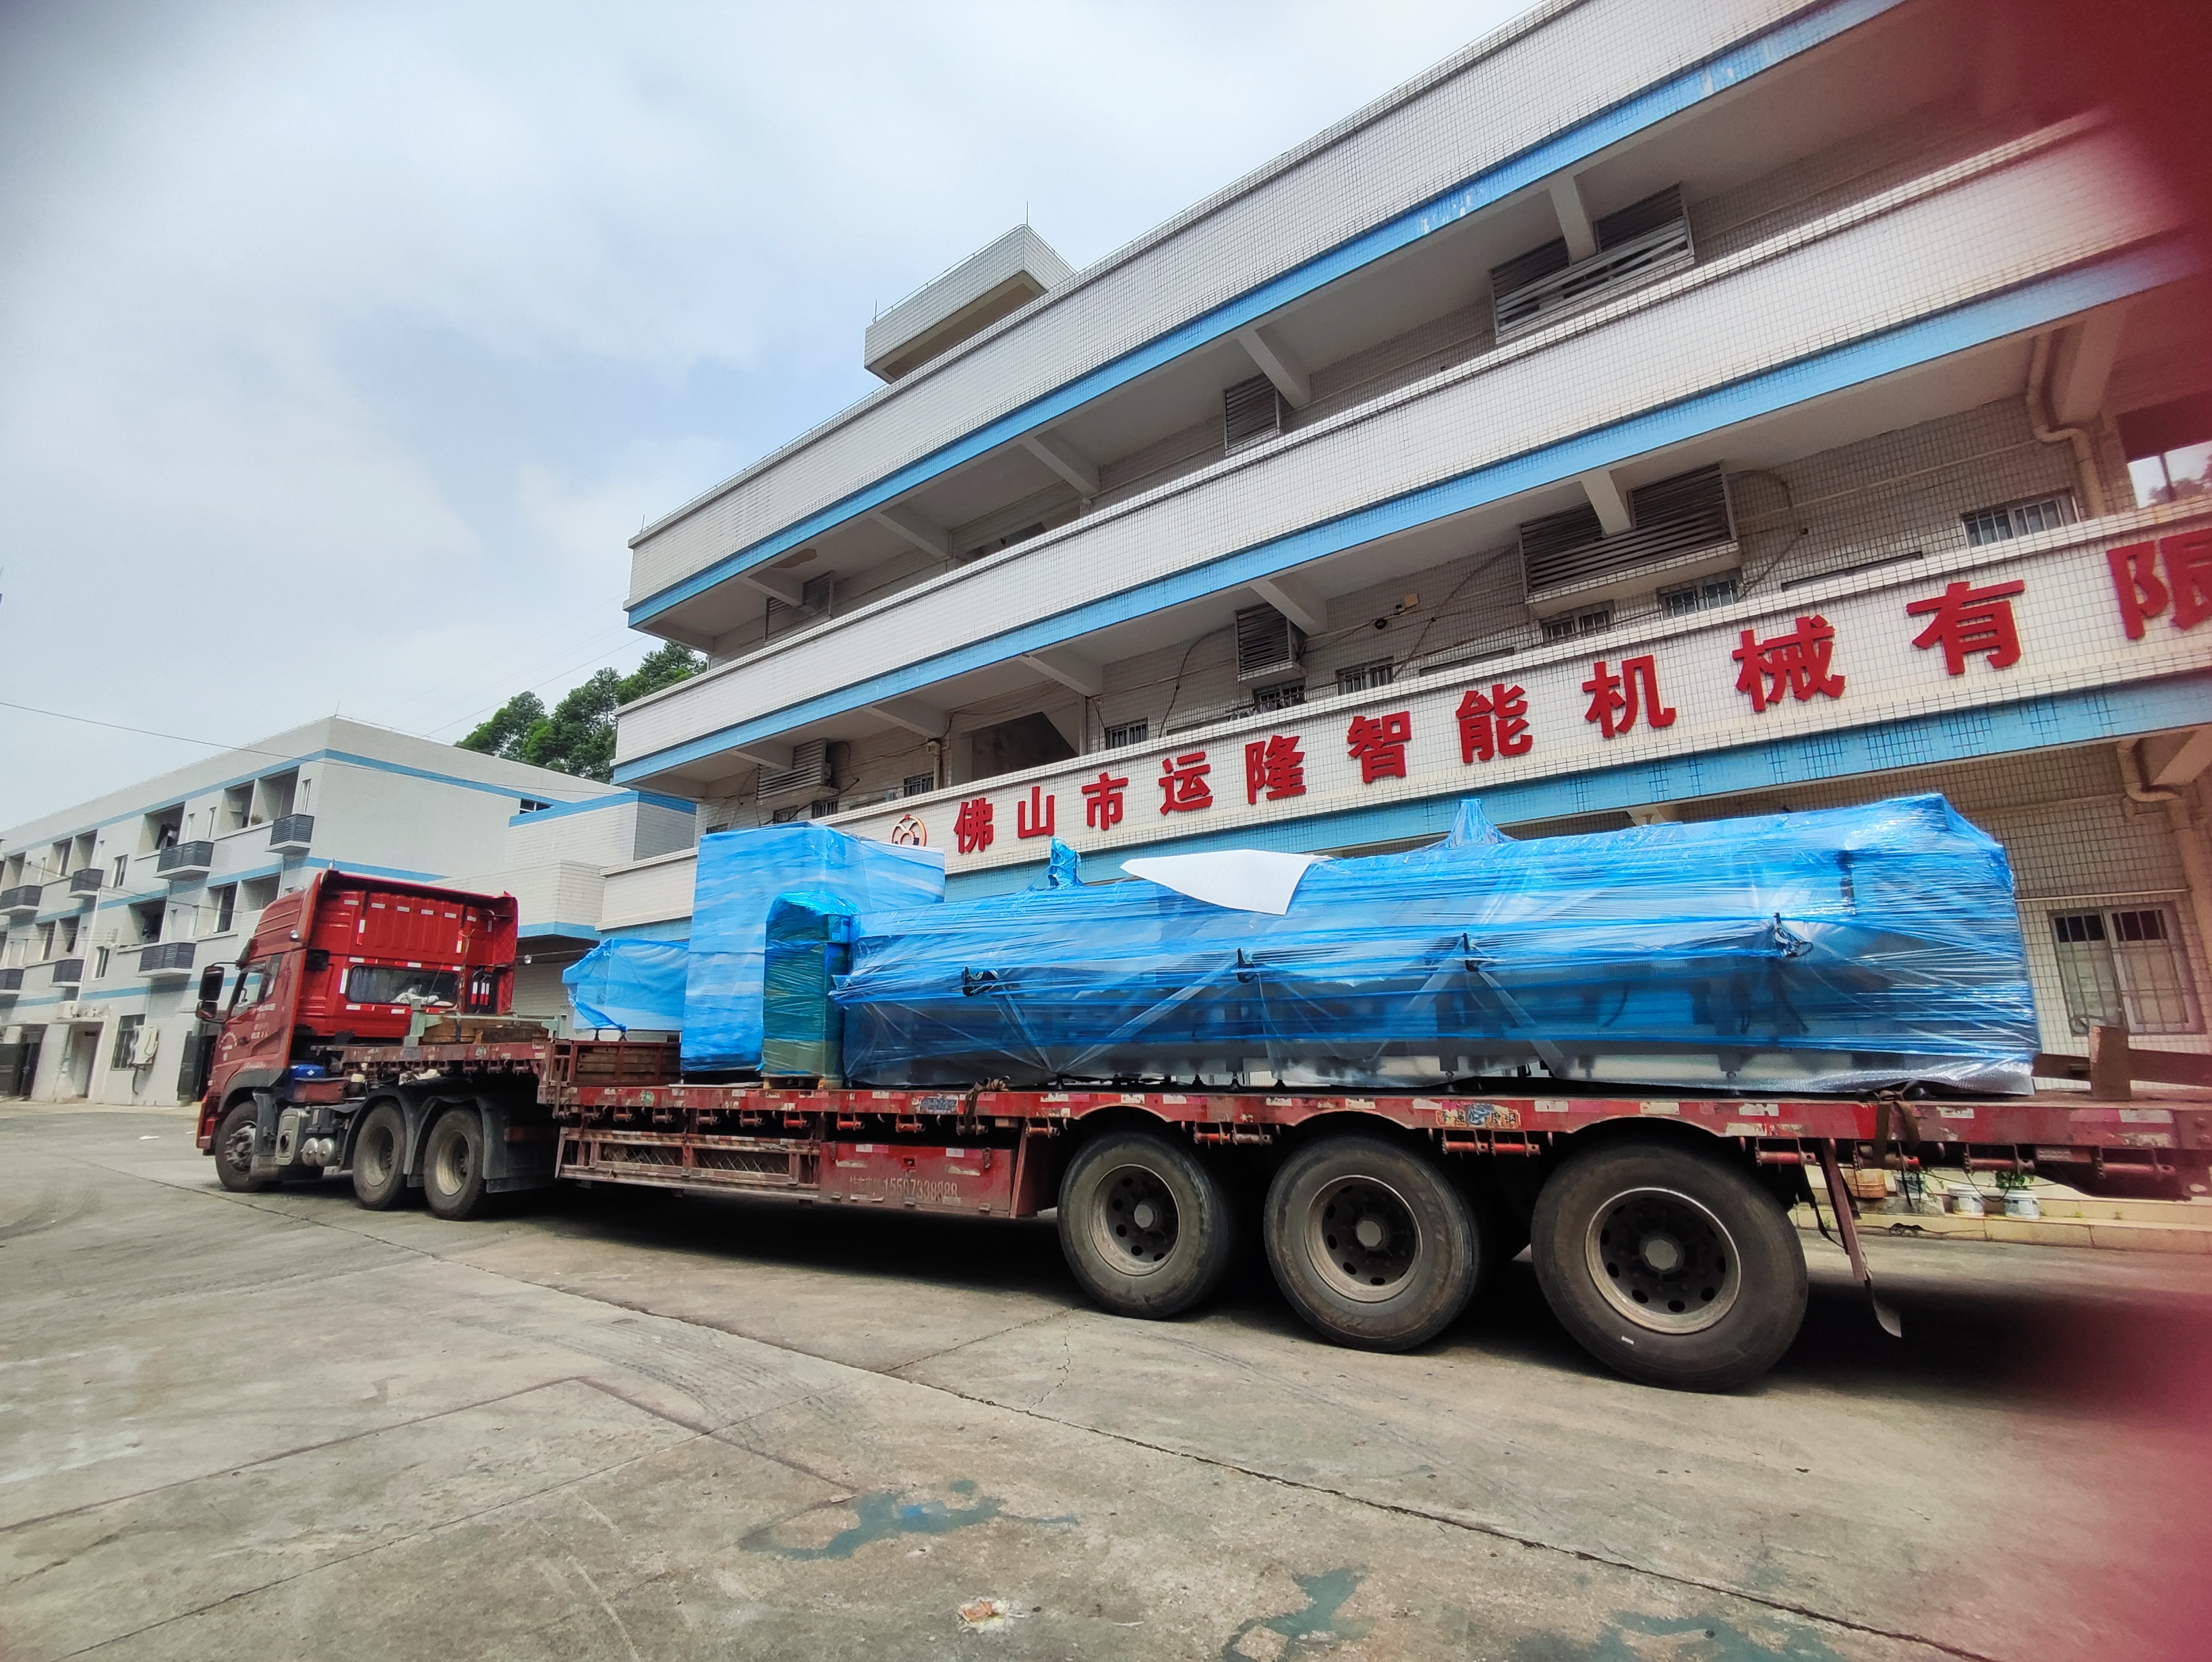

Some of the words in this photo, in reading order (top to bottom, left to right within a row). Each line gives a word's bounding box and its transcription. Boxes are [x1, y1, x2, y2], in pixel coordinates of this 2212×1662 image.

[953, 527, 2212, 854] 佛山市运隆智能机械有限
